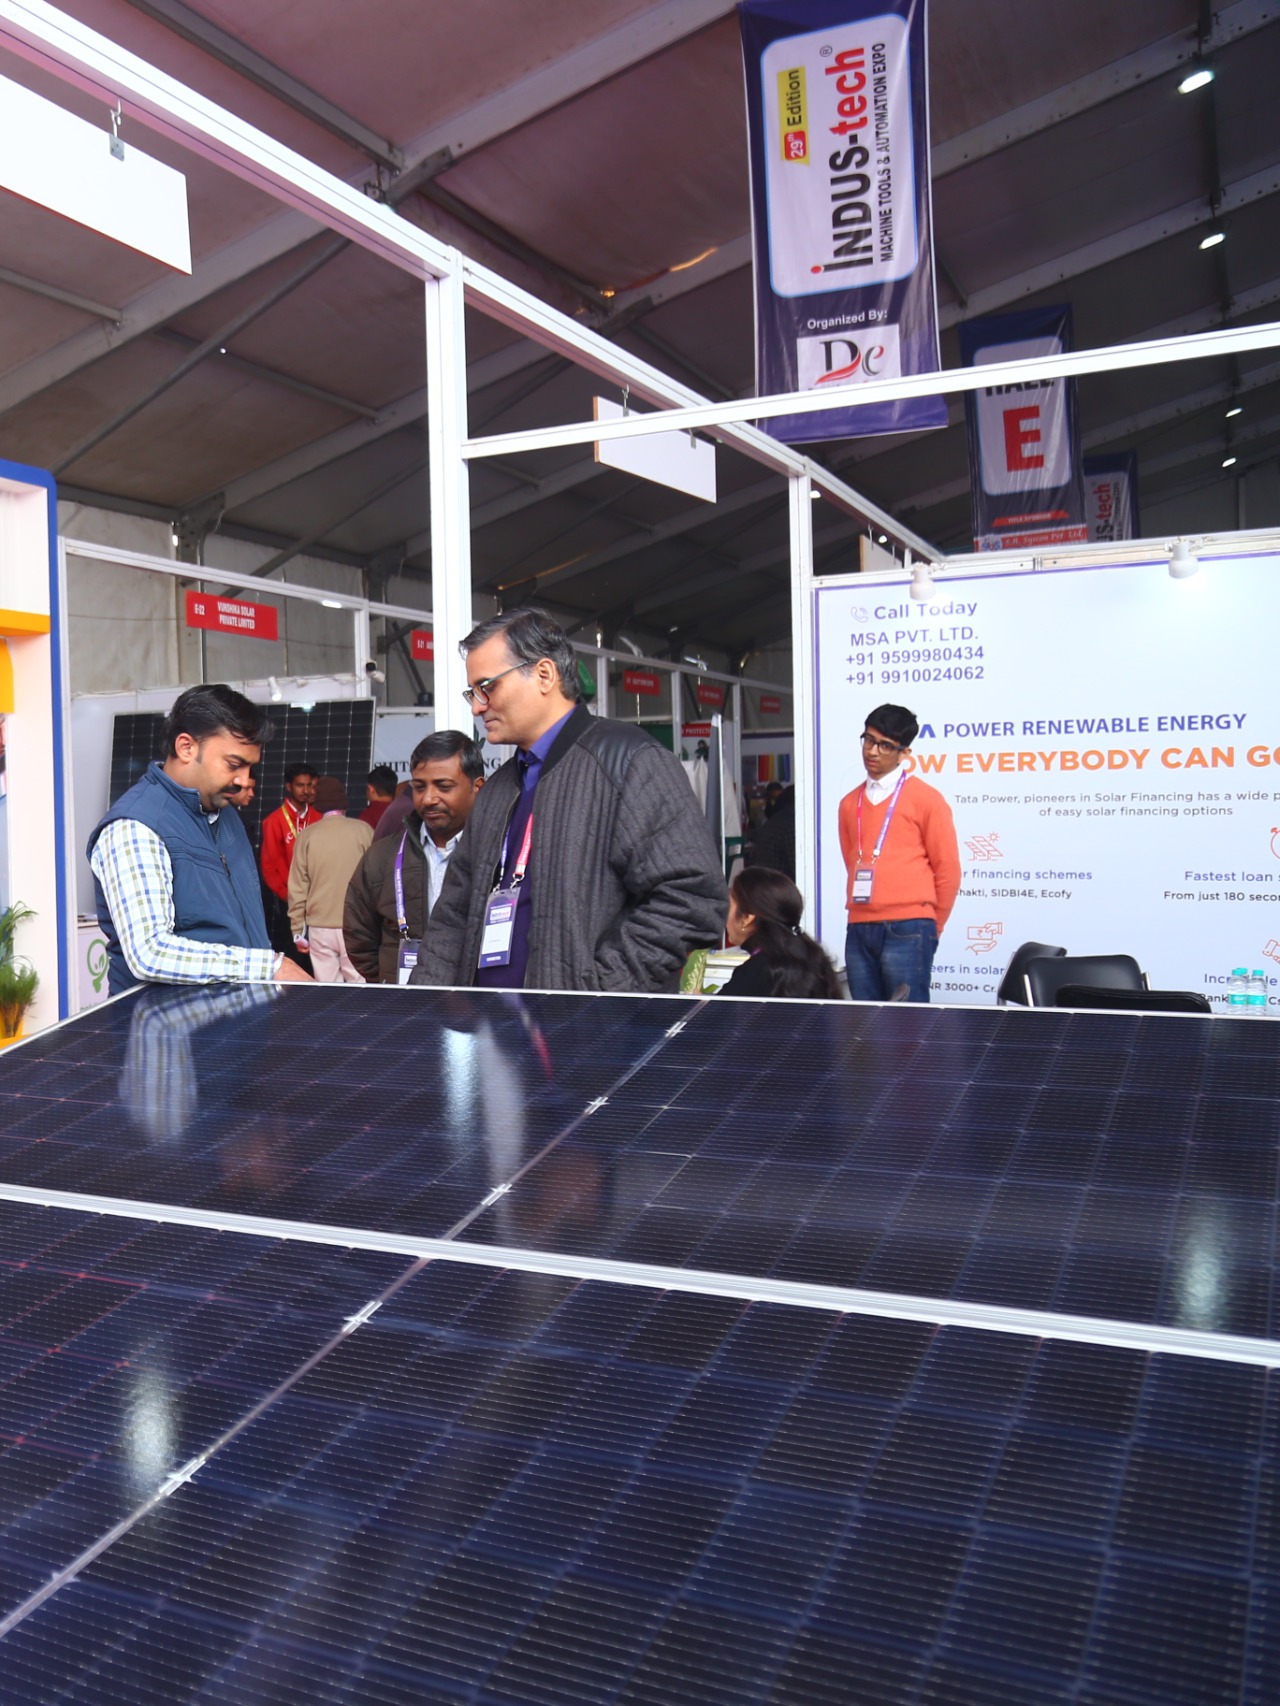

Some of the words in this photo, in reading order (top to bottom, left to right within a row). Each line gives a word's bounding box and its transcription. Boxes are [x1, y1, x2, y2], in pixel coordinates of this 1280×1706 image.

[872, 42, 886, 85] EXPO
[787, 69, 803, 127] Edition
[873, 88, 890, 153] AUTOMATION
[877, 156, 890, 166] &
[877, 169, 892, 207] TOOLS
[878, 209, 894, 262] MACHINE
[807, 311, 865, 330] Organized
[868, 308, 888, 322] By:
[1003, 405, 1044, 472] E
[874, 604, 910, 620] Call
[916, 600, 978, 617] Today
[219, 614, 238, 627] PRIVATE
[238, 617, 256, 630] LIMITED
[850, 631, 889, 647] MSA
[895, 629, 933, 644] PVT.
[939, 626, 979, 642] LTD.
[846, 651, 874, 666] +91
[881, 645, 984, 665] 9599980434
[846, 671, 874, 686] +91
[881, 665, 985, 684] 9910024062
[944, 721, 1015, 739] POWER
[1022, 716, 1150, 736] RENEWABLE
[1157, 713, 1247, 732] ENERGY
[901, 753, 947, 774] OW
[956, 749, 1151, 773] EVERYBODY
[1160, 746, 1235, 769] CAN
[955, 794, 979, 804] Tata
[982, 794, 1020, 804] Power,
[1024, 793, 1076, 804] pioneers
[1080, 793, 1091, 803] in
[1095, 792, 1127, 802] Solar
[1131, 791, 1193, 803] Financing
[1197, 791, 1220, 801] has
[1224, 793, 1232, 801] a
[1236, 790, 1269, 801] wide
[1039, 807, 1052, 817] of
[1055, 809, 1082, 818] easy
[1086, 806, 1117, 816] solar
[1120, 806, 1179, 817] financing
[1183, 805, 1234, 817] options
[972, 869, 1031, 881] financing
[1035, 870, 1093, 880] schemes
[1184, 871, 1237, 882] Fastest
[1241, 871, 1273, 882] loan
[957, 889, 988, 898] hakti,
[1041, 889, 1072, 899] Ecofy
[1164, 891, 1195, 900] From
[1198, 891, 1220, 901] just
[1224, 892, 1245, 901] 180
[959, 964, 970, 974] in
[974, 964, 1005, 975] solar
[944, 982, 980, 992] 3000+
[983, 983, 997, 993] Cr.
